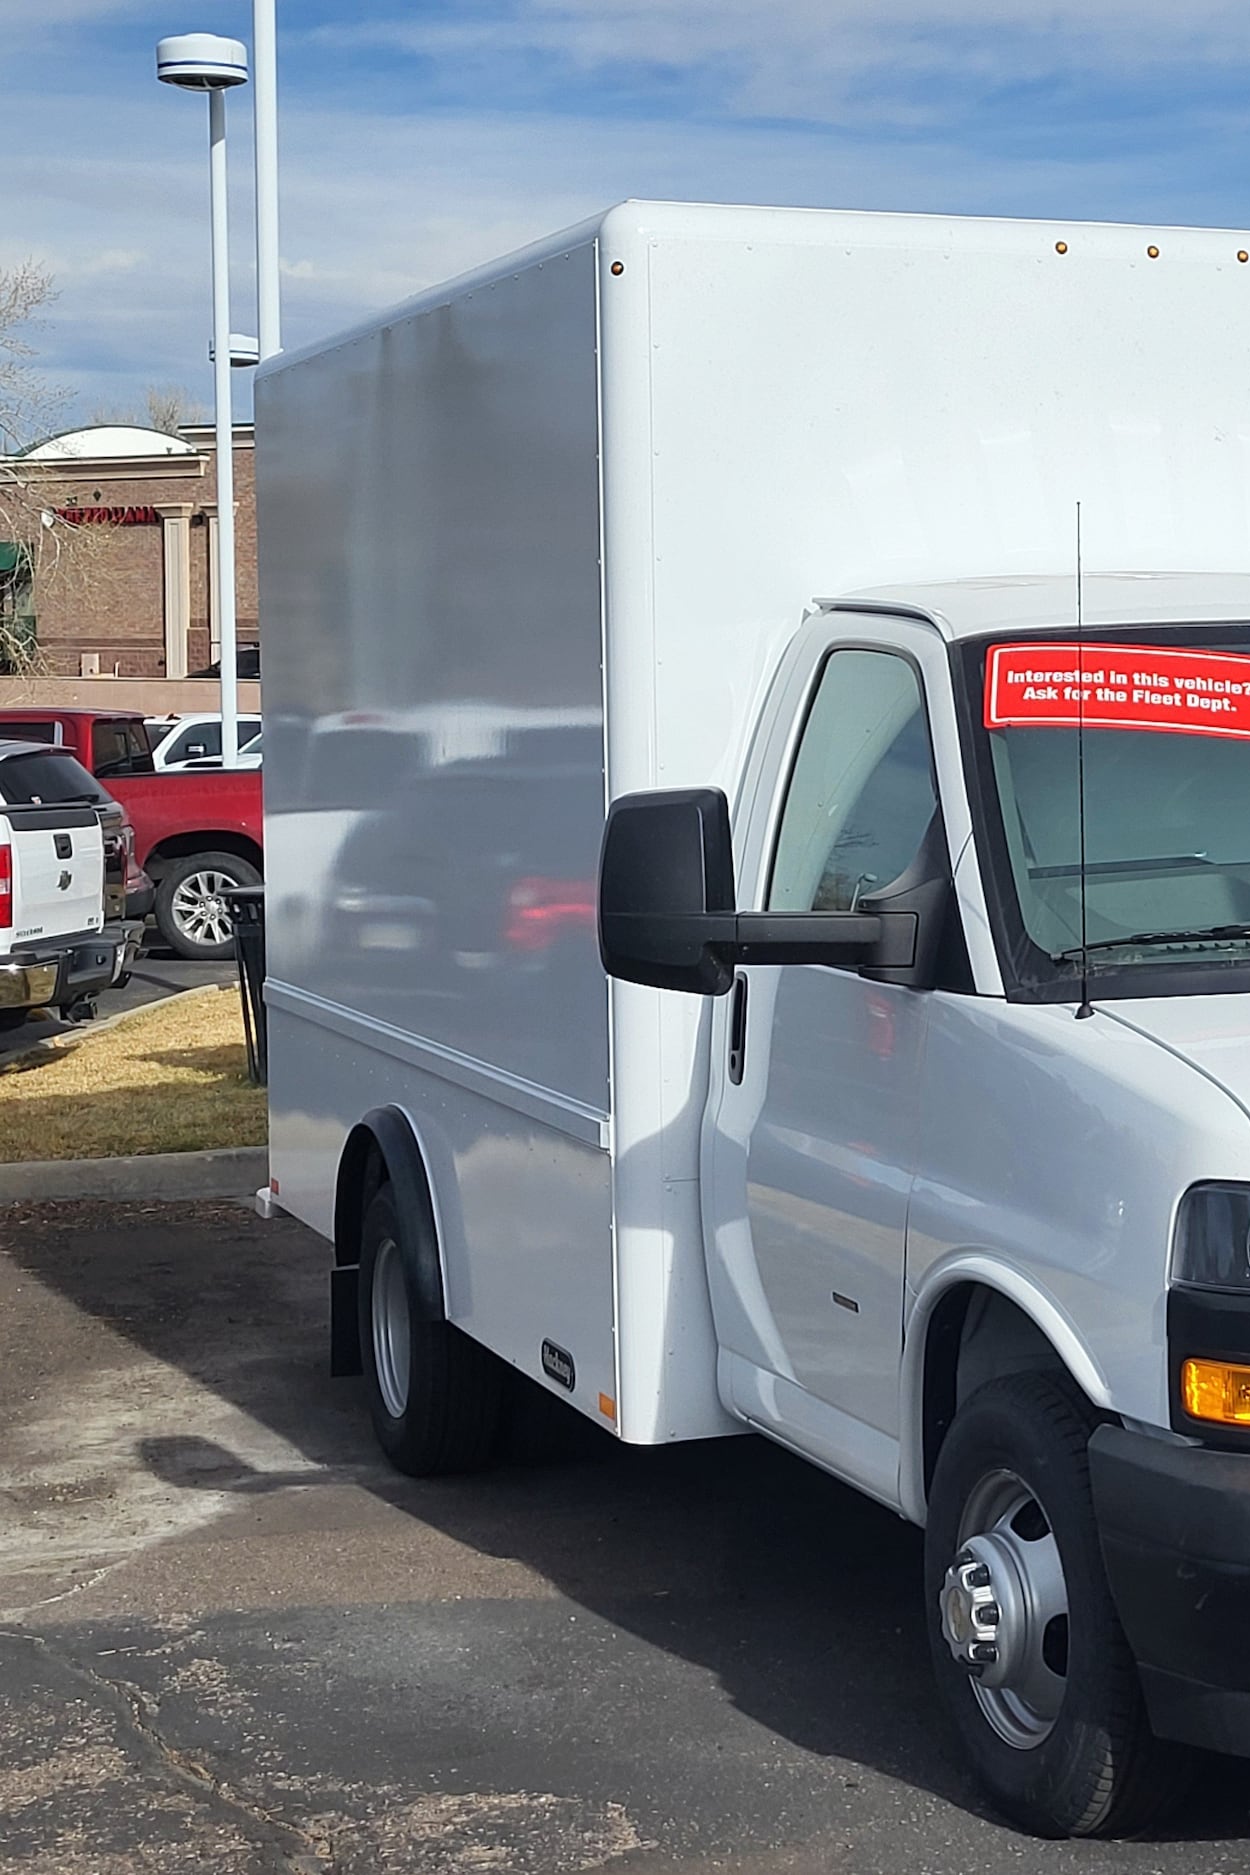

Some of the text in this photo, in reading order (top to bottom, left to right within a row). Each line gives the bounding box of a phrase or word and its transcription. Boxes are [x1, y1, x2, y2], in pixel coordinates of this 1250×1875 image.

[1006, 670, 1105, 684] Interested
[1109, 671, 1128, 685] in
[1132, 672, 1170, 687] this
[1022, 686, 1237, 712] Ask for the Fleet Dept.
